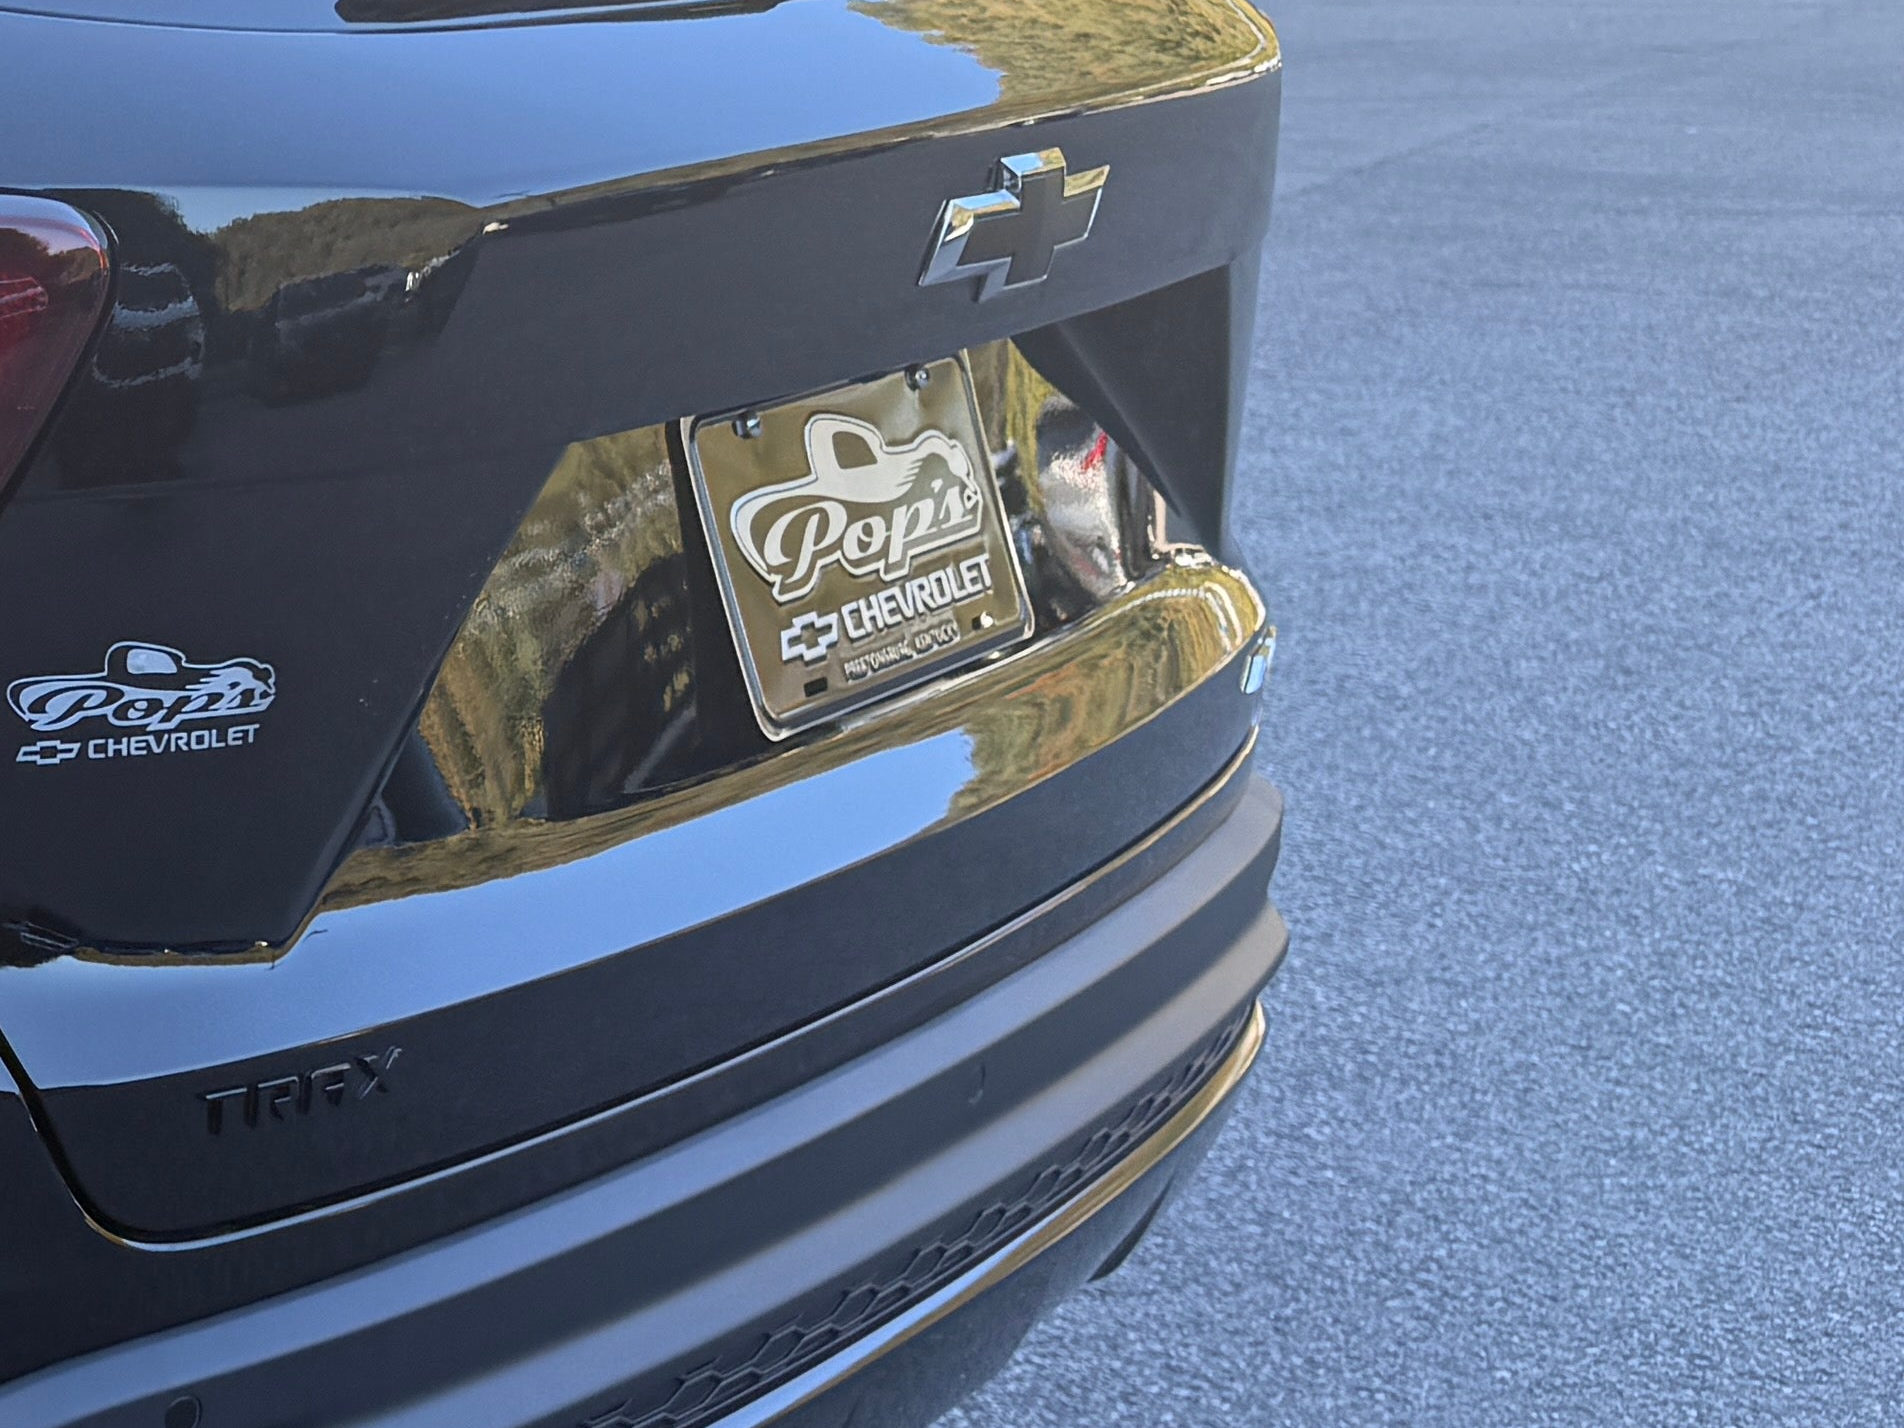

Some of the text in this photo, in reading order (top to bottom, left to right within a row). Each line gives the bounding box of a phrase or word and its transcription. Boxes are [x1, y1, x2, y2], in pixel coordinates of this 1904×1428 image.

[764, 477, 972, 582] Pop's
[843, 554, 993, 640] CHEVROLET
[88, 724, 260, 760] CHEVROLET
[197, 1045, 404, 1135] TRAX
